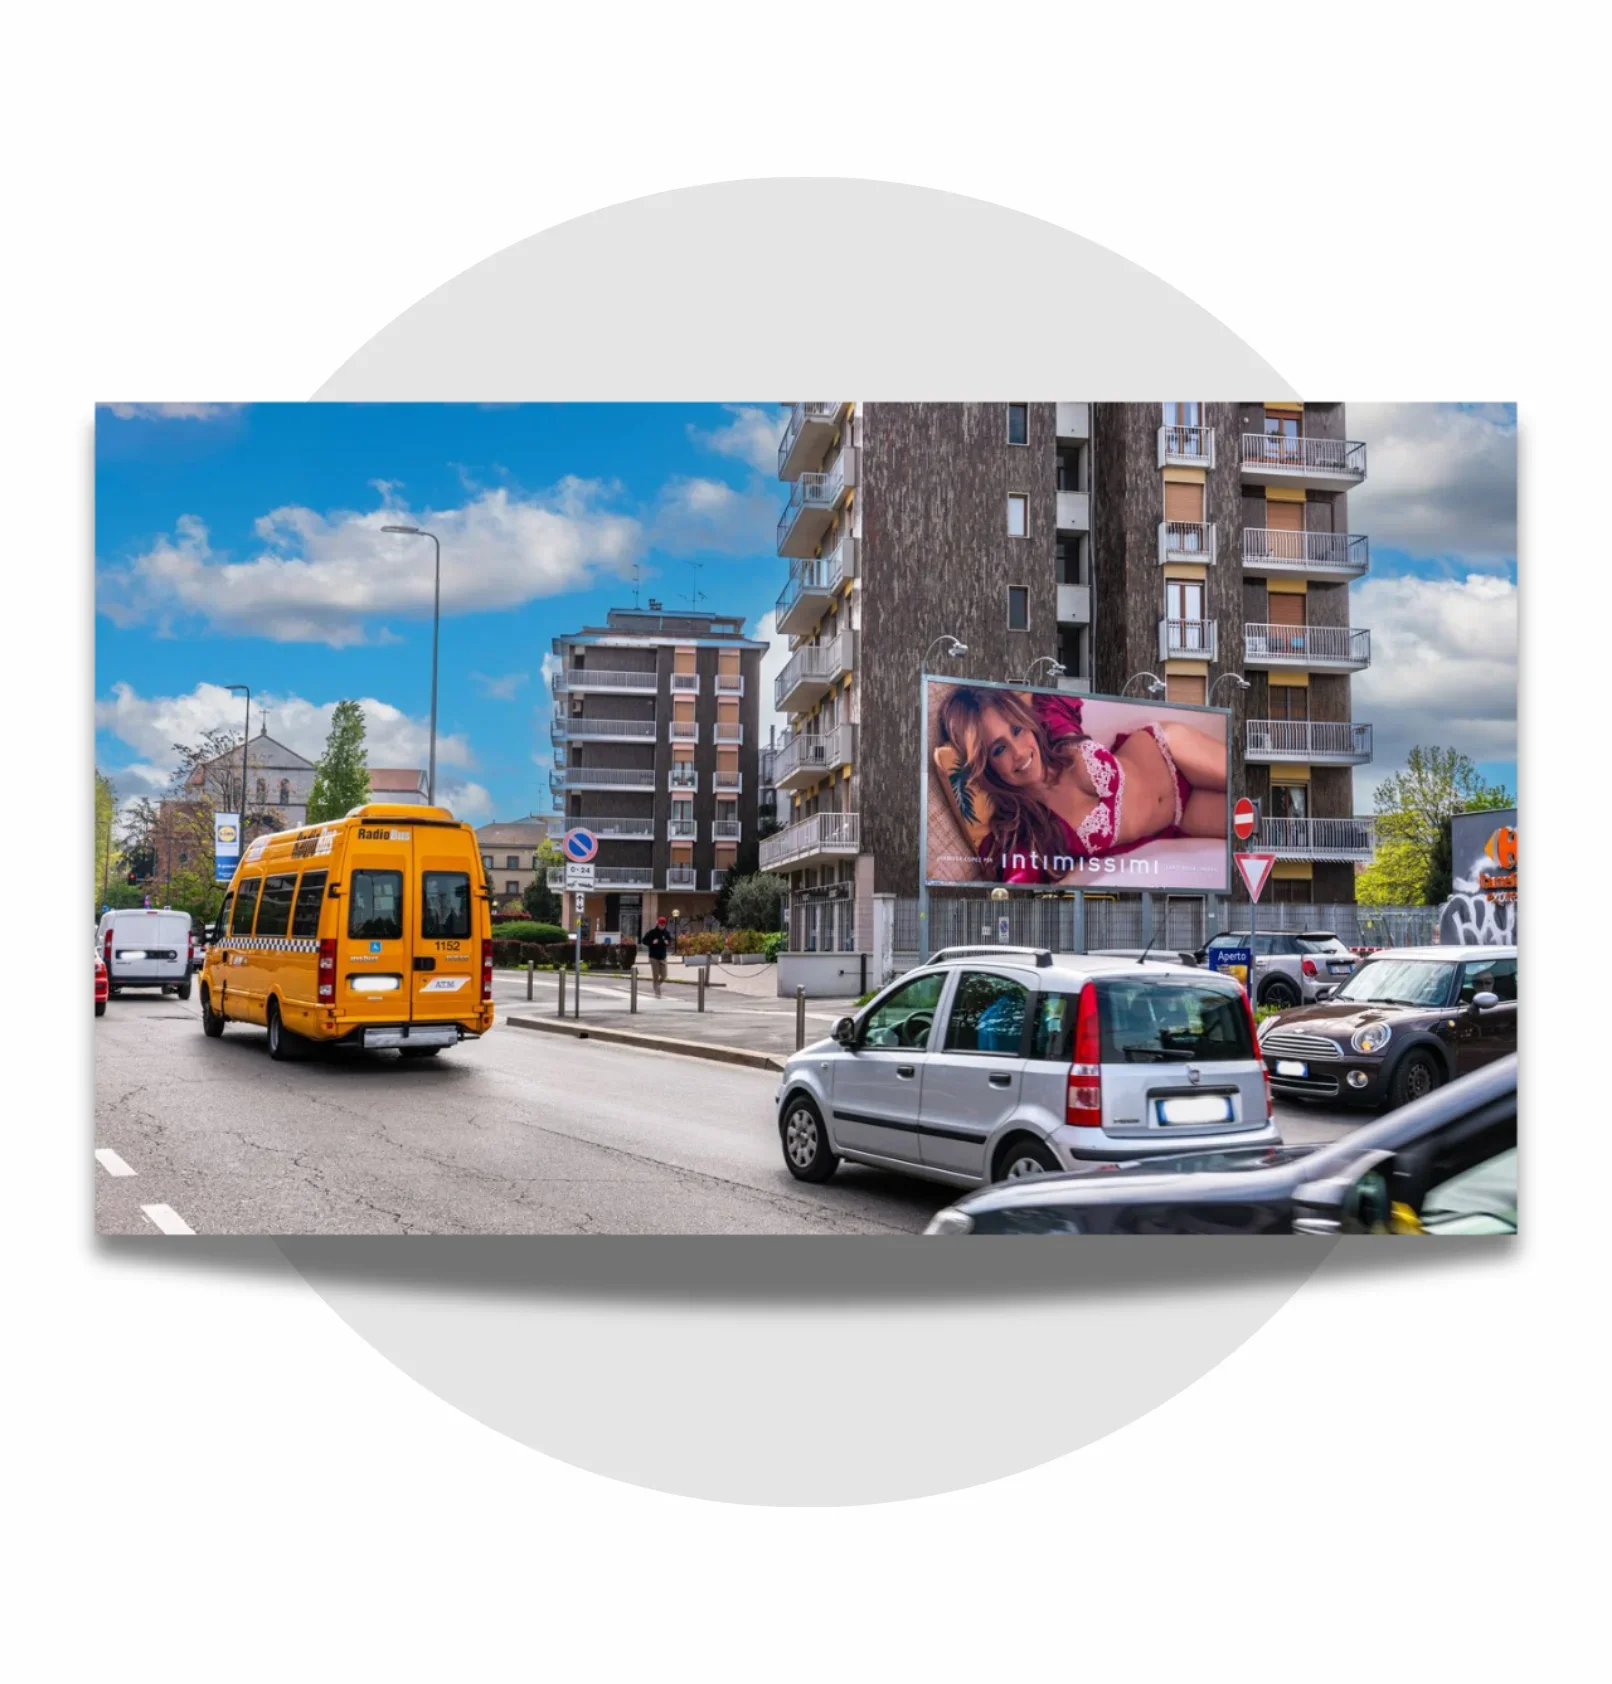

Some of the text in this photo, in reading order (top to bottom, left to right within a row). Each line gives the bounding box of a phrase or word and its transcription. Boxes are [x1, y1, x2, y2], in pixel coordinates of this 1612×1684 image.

[358, 828, 410, 840] RadioBus
[1002, 851, 1159, 875] intimissimi
[435, 941, 460, 951] 1152
[1218, 951, 1246, 963] Aperto
